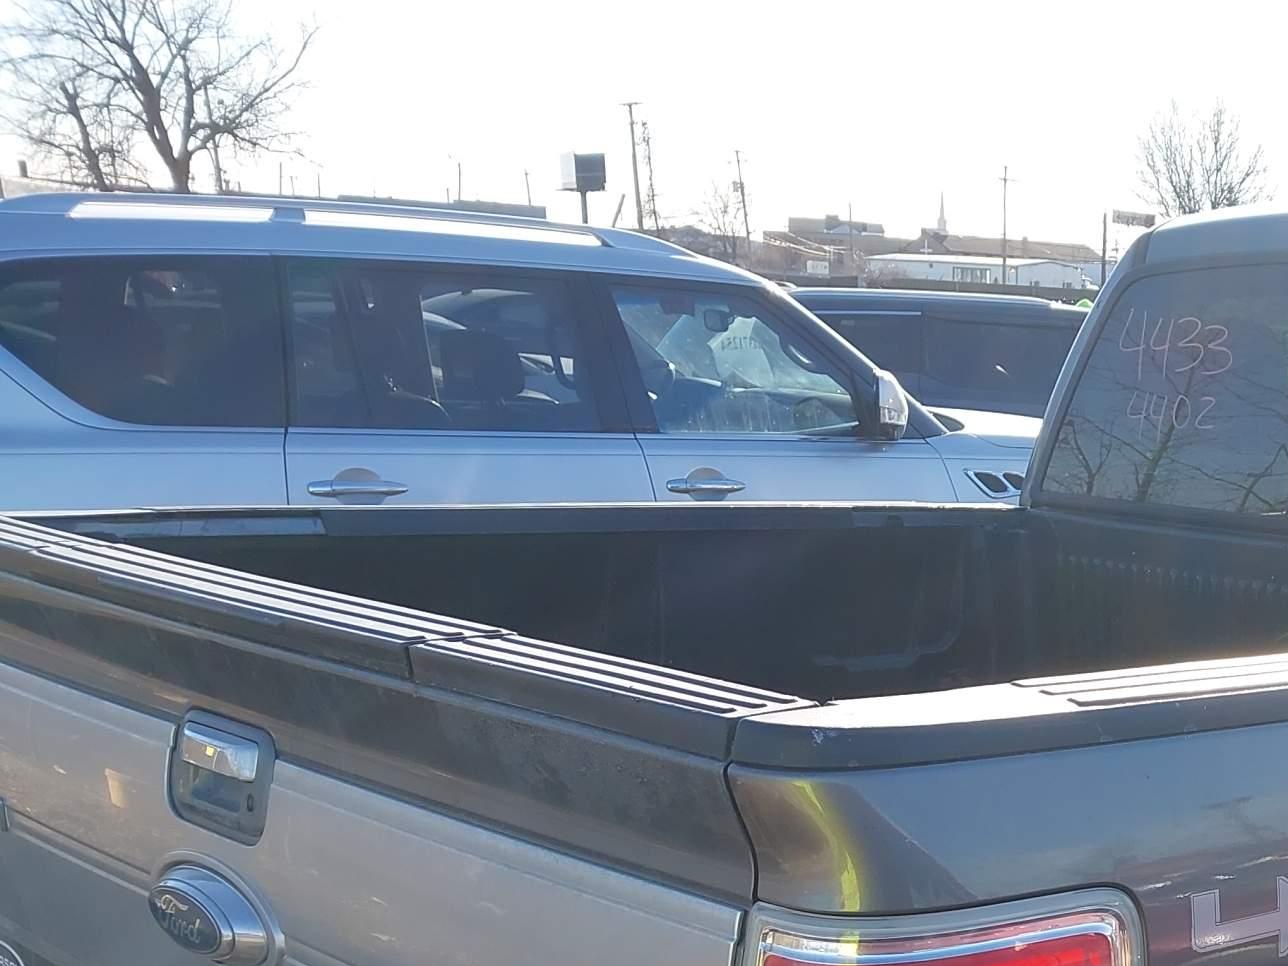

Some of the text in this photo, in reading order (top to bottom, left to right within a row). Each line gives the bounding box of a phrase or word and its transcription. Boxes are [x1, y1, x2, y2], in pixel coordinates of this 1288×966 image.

[1119, 307, 1233, 381] 4433
[1126, 391, 1217, 444] 4402
[153, 894, 202, 944] Ford
